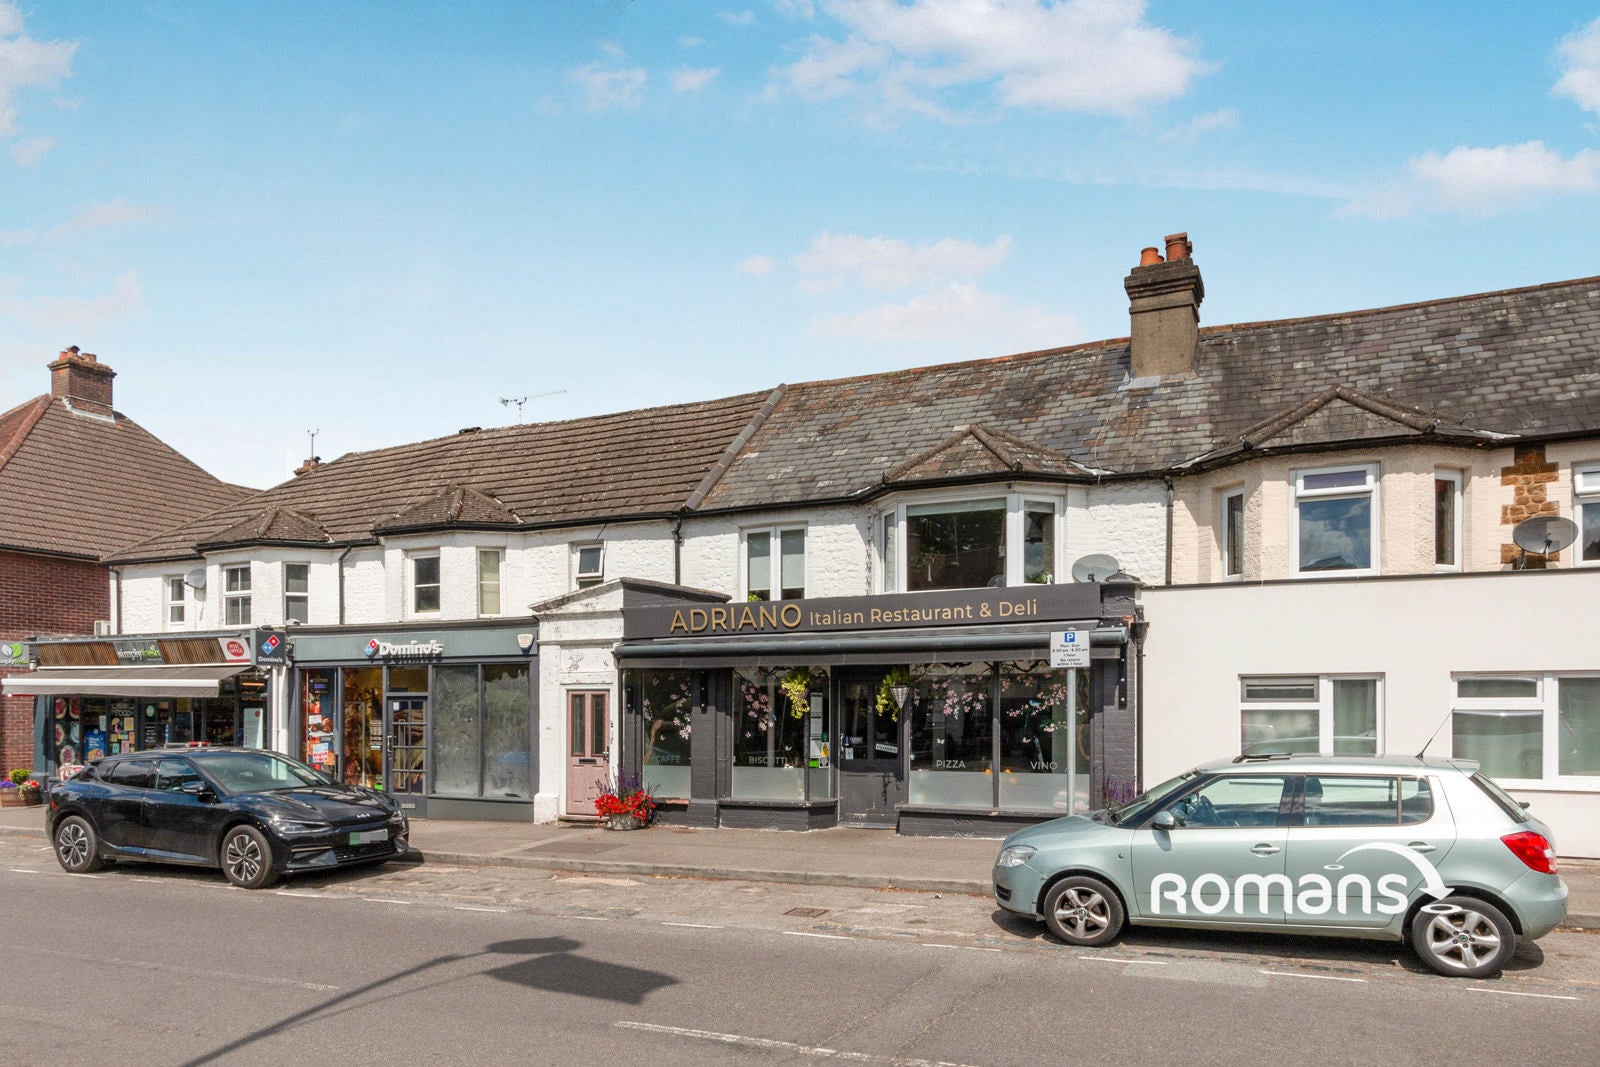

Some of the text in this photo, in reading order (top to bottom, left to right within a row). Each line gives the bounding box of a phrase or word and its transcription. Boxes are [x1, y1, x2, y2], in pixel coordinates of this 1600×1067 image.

[670, 599, 1038, 633] ADRIANO Italian Restaurant & Deli
[379, 639, 444, 656] Domino's
[936, 760, 966, 769] PIZZA
[1030, 761, 1058, 770] VINO
